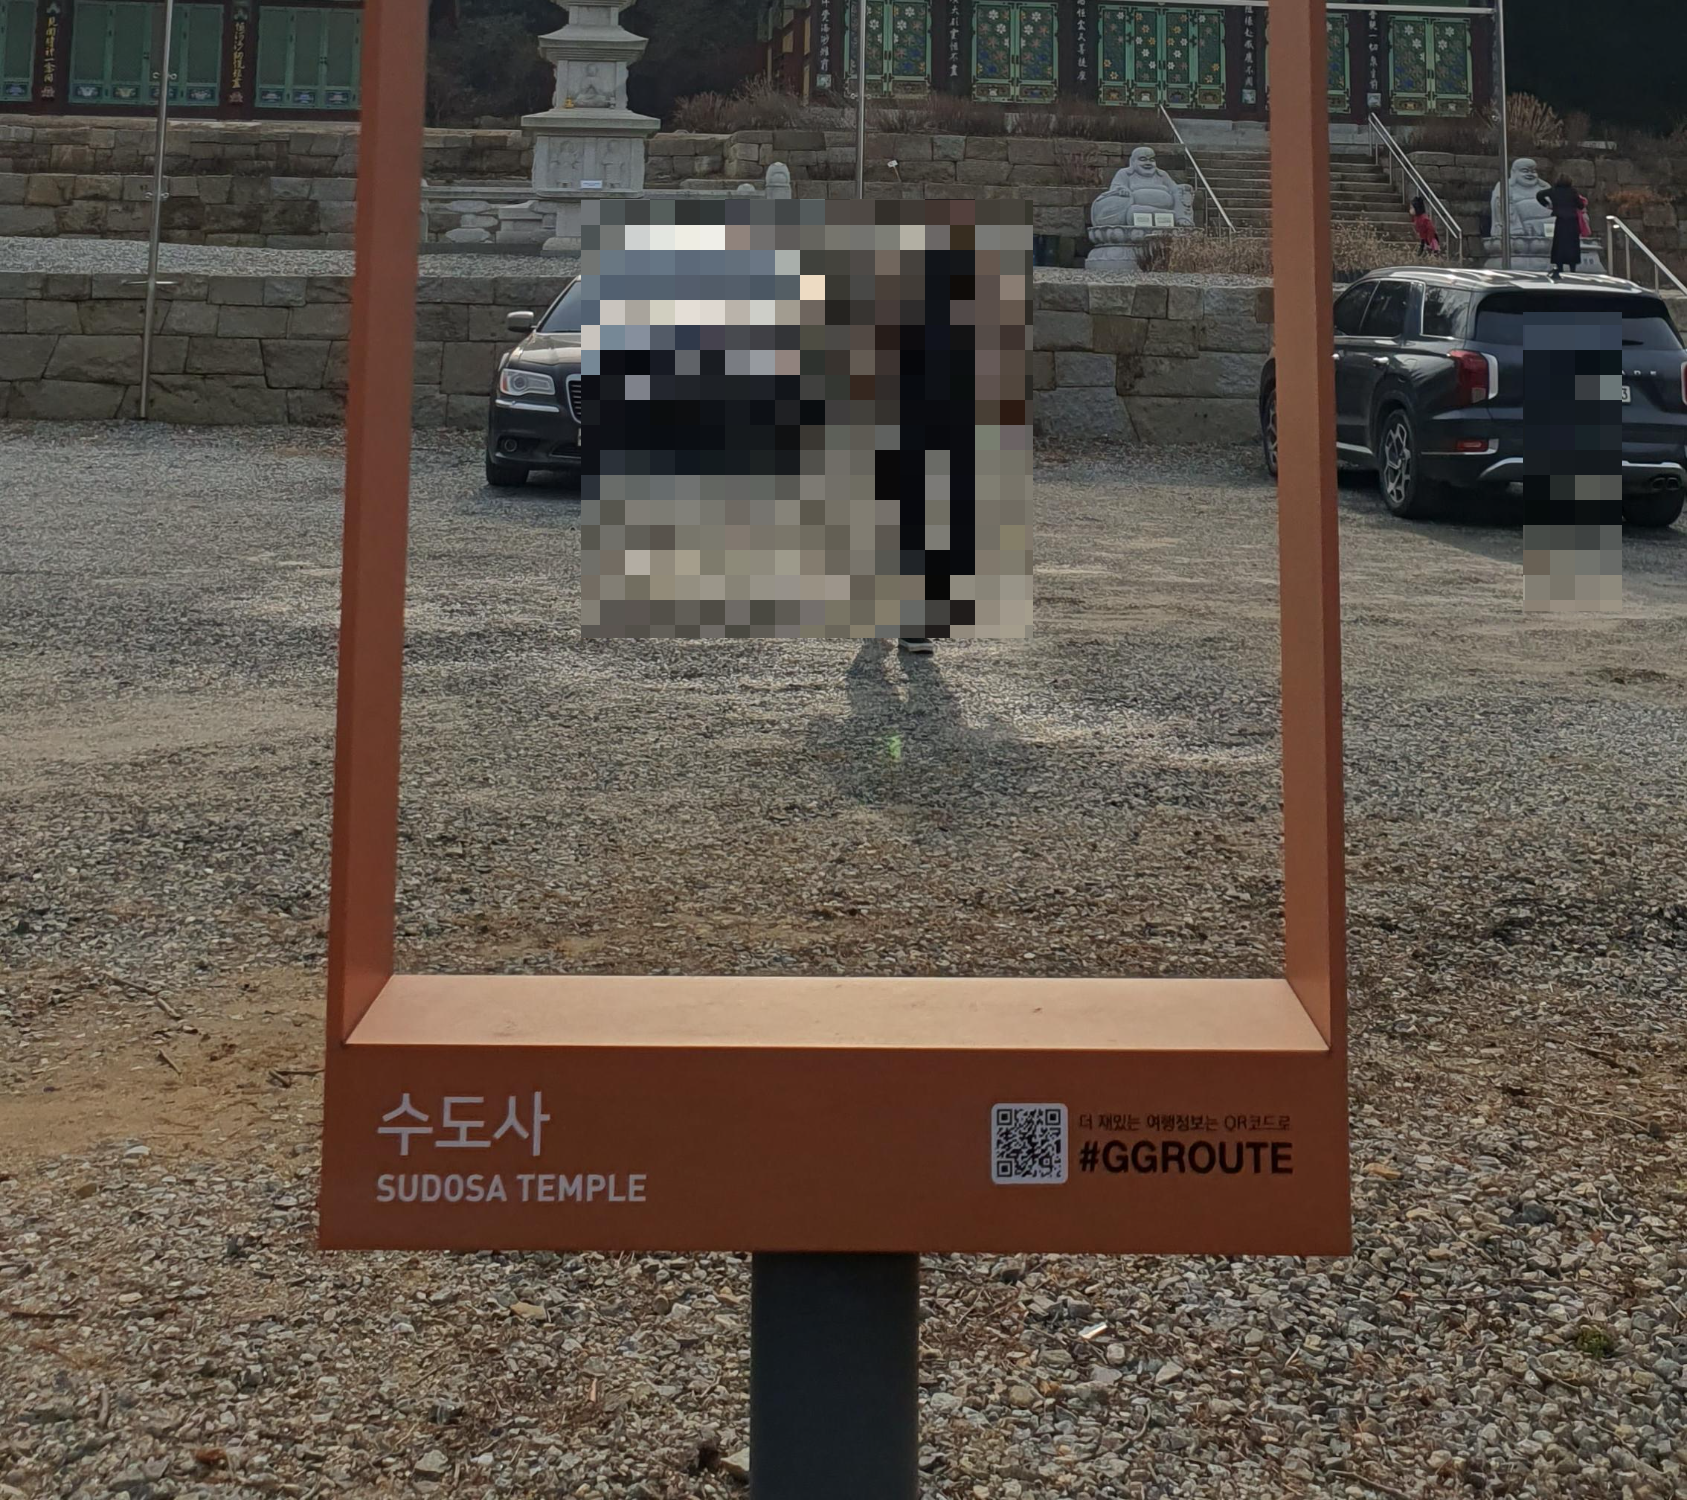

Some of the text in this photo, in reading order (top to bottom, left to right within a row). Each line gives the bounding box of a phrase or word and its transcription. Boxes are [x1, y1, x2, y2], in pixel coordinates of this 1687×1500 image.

[376, 1091, 551, 1157] 수도사
[1078, 1113, 1093, 1131] 더
[1146, 1113, 1219, 1132] 여행정보는
[1078, 1140, 1294, 1174] #GGROUTE
[375, 1173, 648, 1202] SUDOSA TEMPLE
